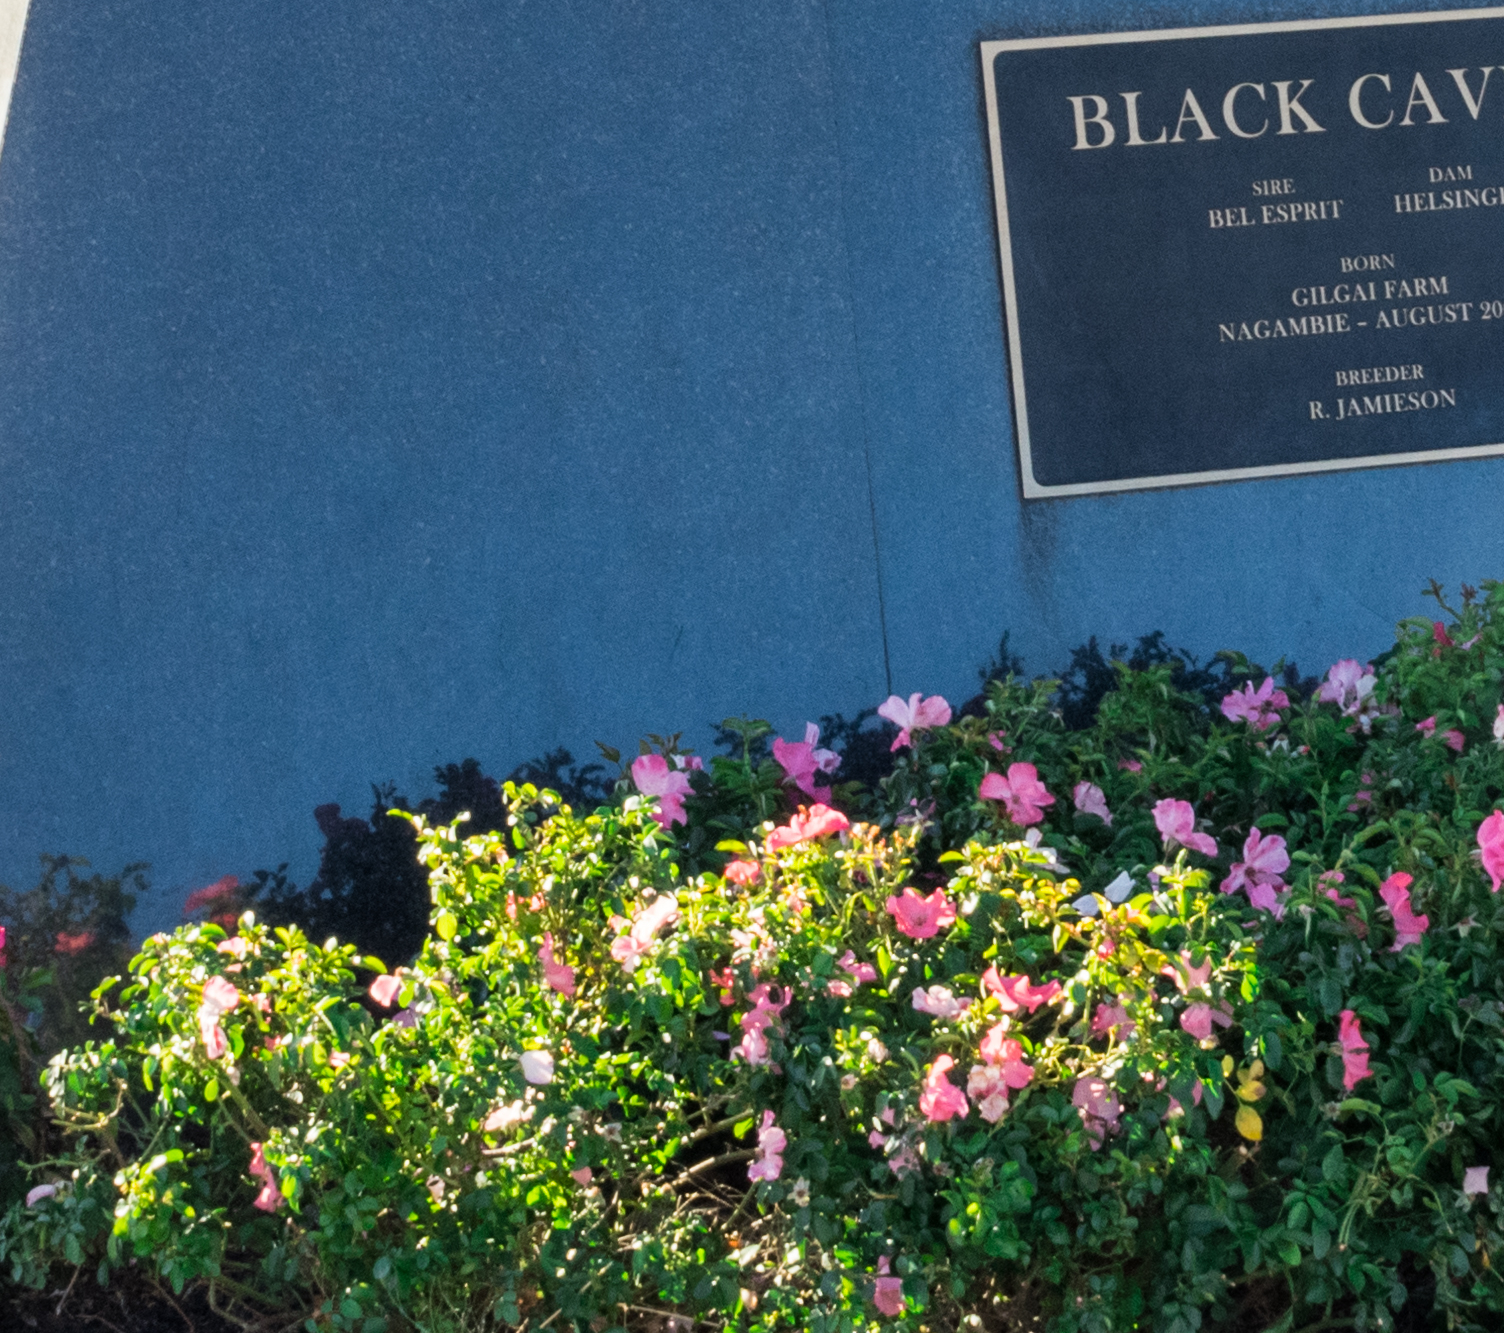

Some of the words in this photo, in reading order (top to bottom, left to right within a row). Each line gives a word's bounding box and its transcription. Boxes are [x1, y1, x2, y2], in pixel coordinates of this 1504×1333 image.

[1067, 80, 1326, 149] BLACK
[1253, 179, 1296, 195] SIRE
[1430, 166, 1472, 182] DAM
[1209, 208, 1255, 227] BEL
[1262, 201, 1344, 223] ESPRIT
[1341, 254, 1394, 272] BORN
[1292, 283, 1375, 306] GILGAI
[1385, 276, 1448, 298] FARM
[1218, 314, 1350, 341] NAGAMBIE
[1375, 303, 1472, 328] AUGUST
[1336, 365, 1423, 385] BREEDER
[1310, 402, 1329, 419] R.
[1336, 389, 1455, 419] JAMIESON
